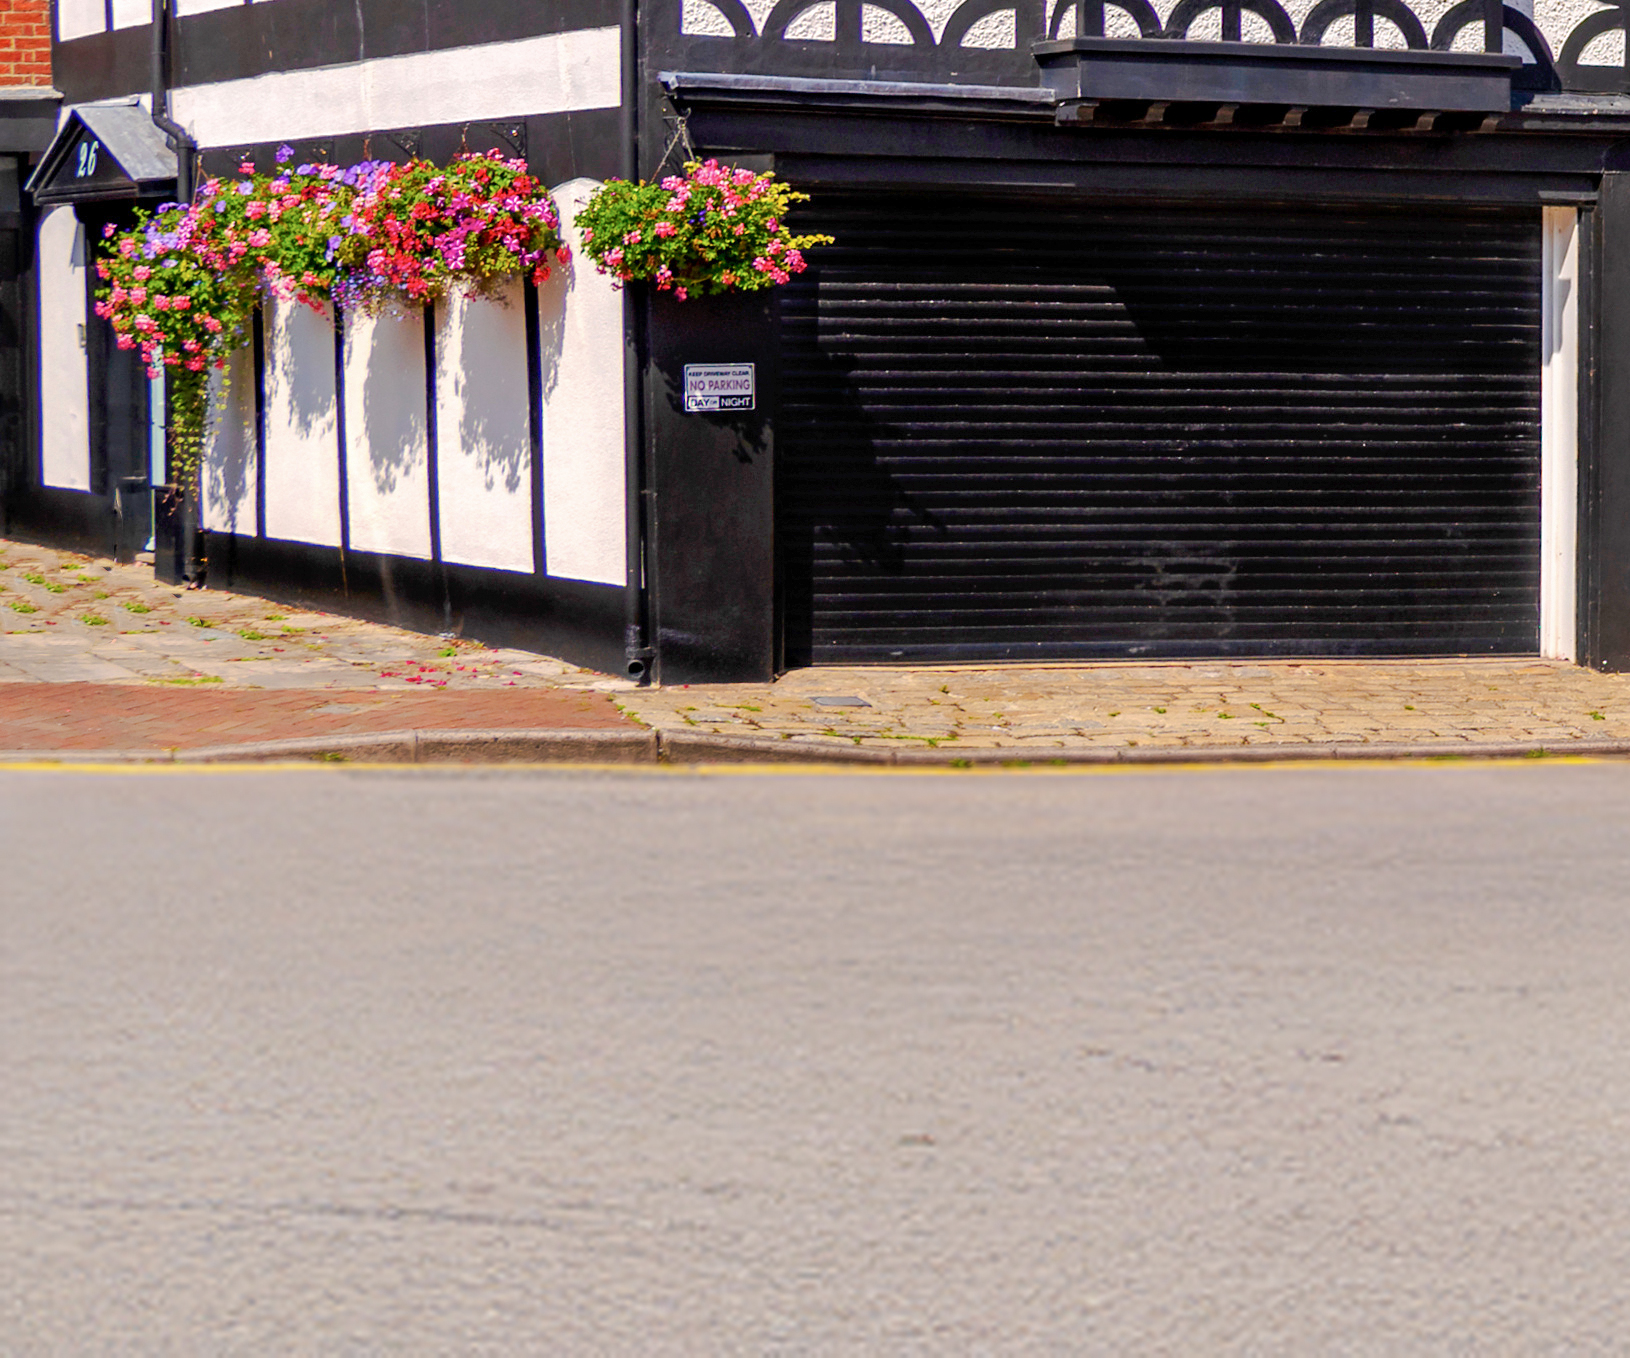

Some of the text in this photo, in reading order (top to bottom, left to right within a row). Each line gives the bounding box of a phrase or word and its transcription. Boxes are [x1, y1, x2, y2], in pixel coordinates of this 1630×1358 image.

[77, 141, 99, 178] 26
[690, 379, 750, 391] NO PARKING
[691, 398, 710, 406] DAY
[721, 397, 751, 407] NIGHT
